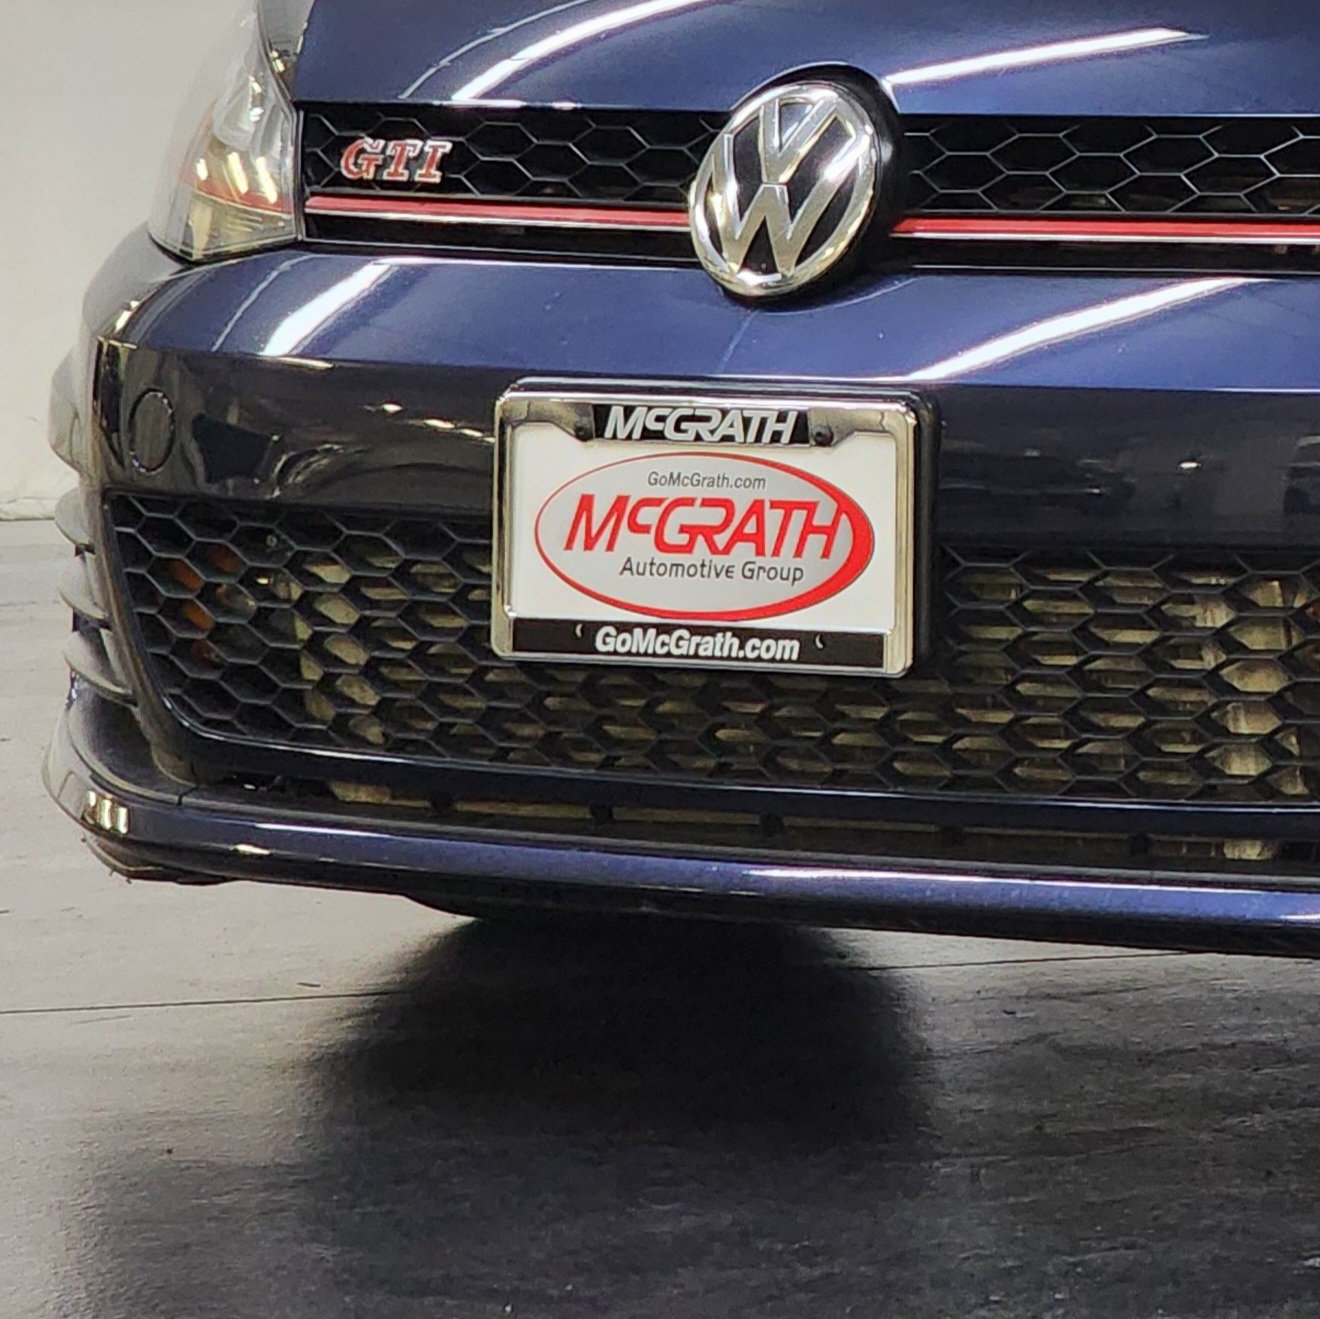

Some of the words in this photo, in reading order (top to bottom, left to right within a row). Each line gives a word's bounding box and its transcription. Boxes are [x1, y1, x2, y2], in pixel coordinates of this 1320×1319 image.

[340, 138, 452, 184] GTI
[698, 82, 874, 284] VW
[647, 470, 767, 491] GoMcGrath.com
[619, 555, 736, 580] Automotive
[741, 560, 805, 587] Group
[594, 624, 800, 662] GoMcGrath.com
